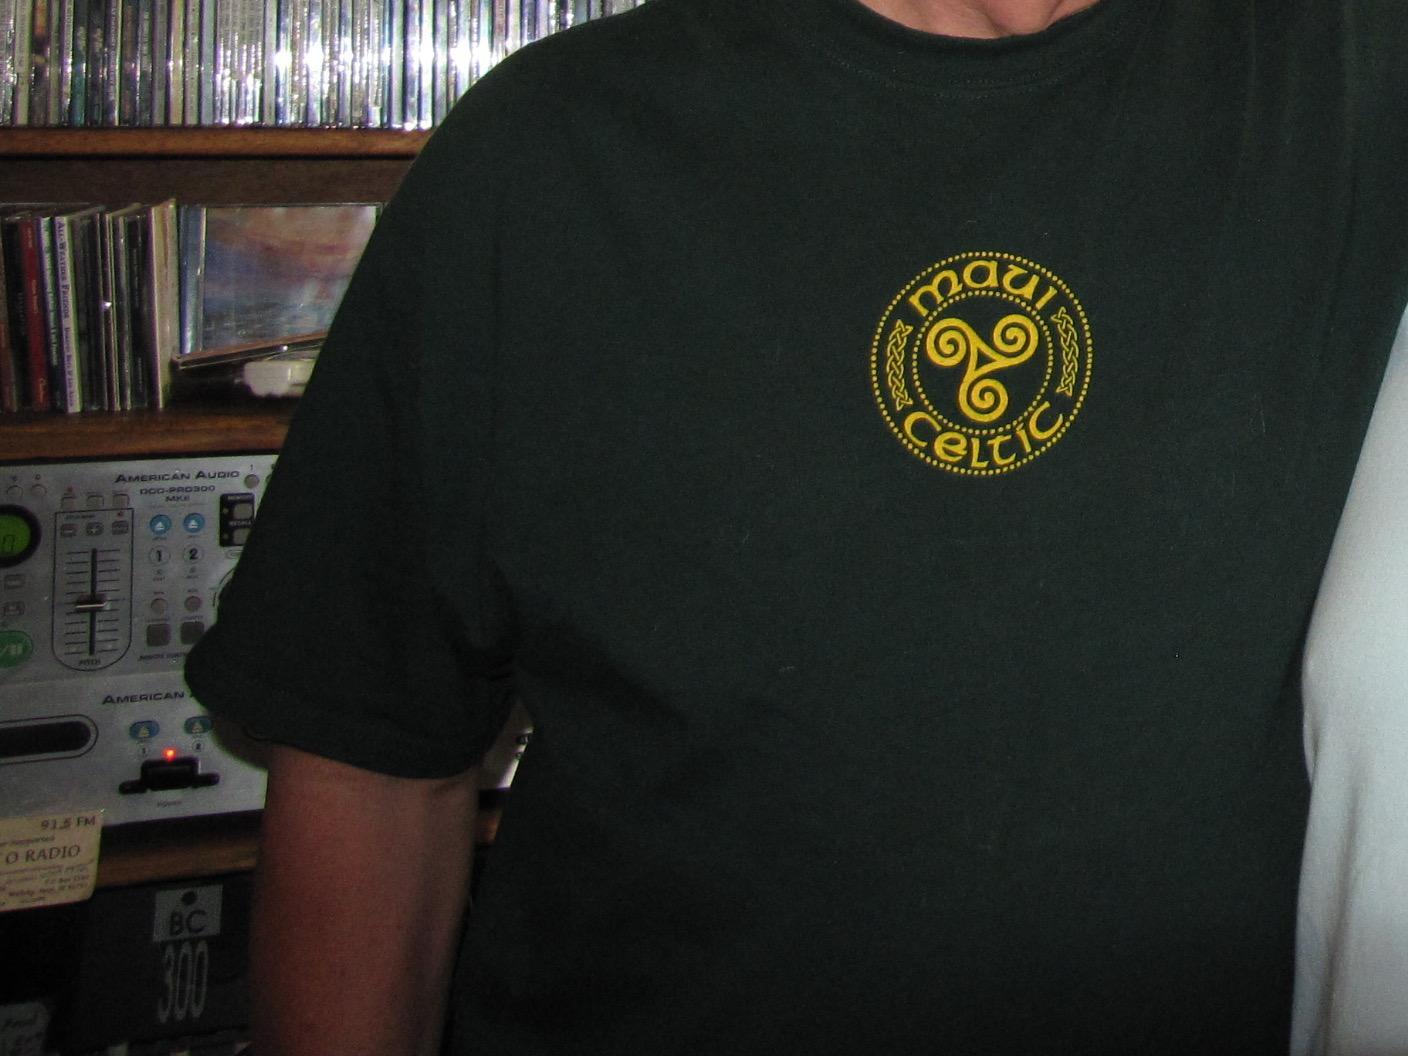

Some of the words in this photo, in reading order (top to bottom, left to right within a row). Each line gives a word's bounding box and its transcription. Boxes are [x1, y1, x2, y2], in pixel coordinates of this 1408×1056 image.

[114, 472, 191, 483] AMERICAN
[195, 470, 240, 480] AUDIO
[102, 692, 185, 705] AMERICAN
[76, 816, 96, 826] FM
[25, 845, 81, 862] RADIO
[170, 909, 208, 936] BC
